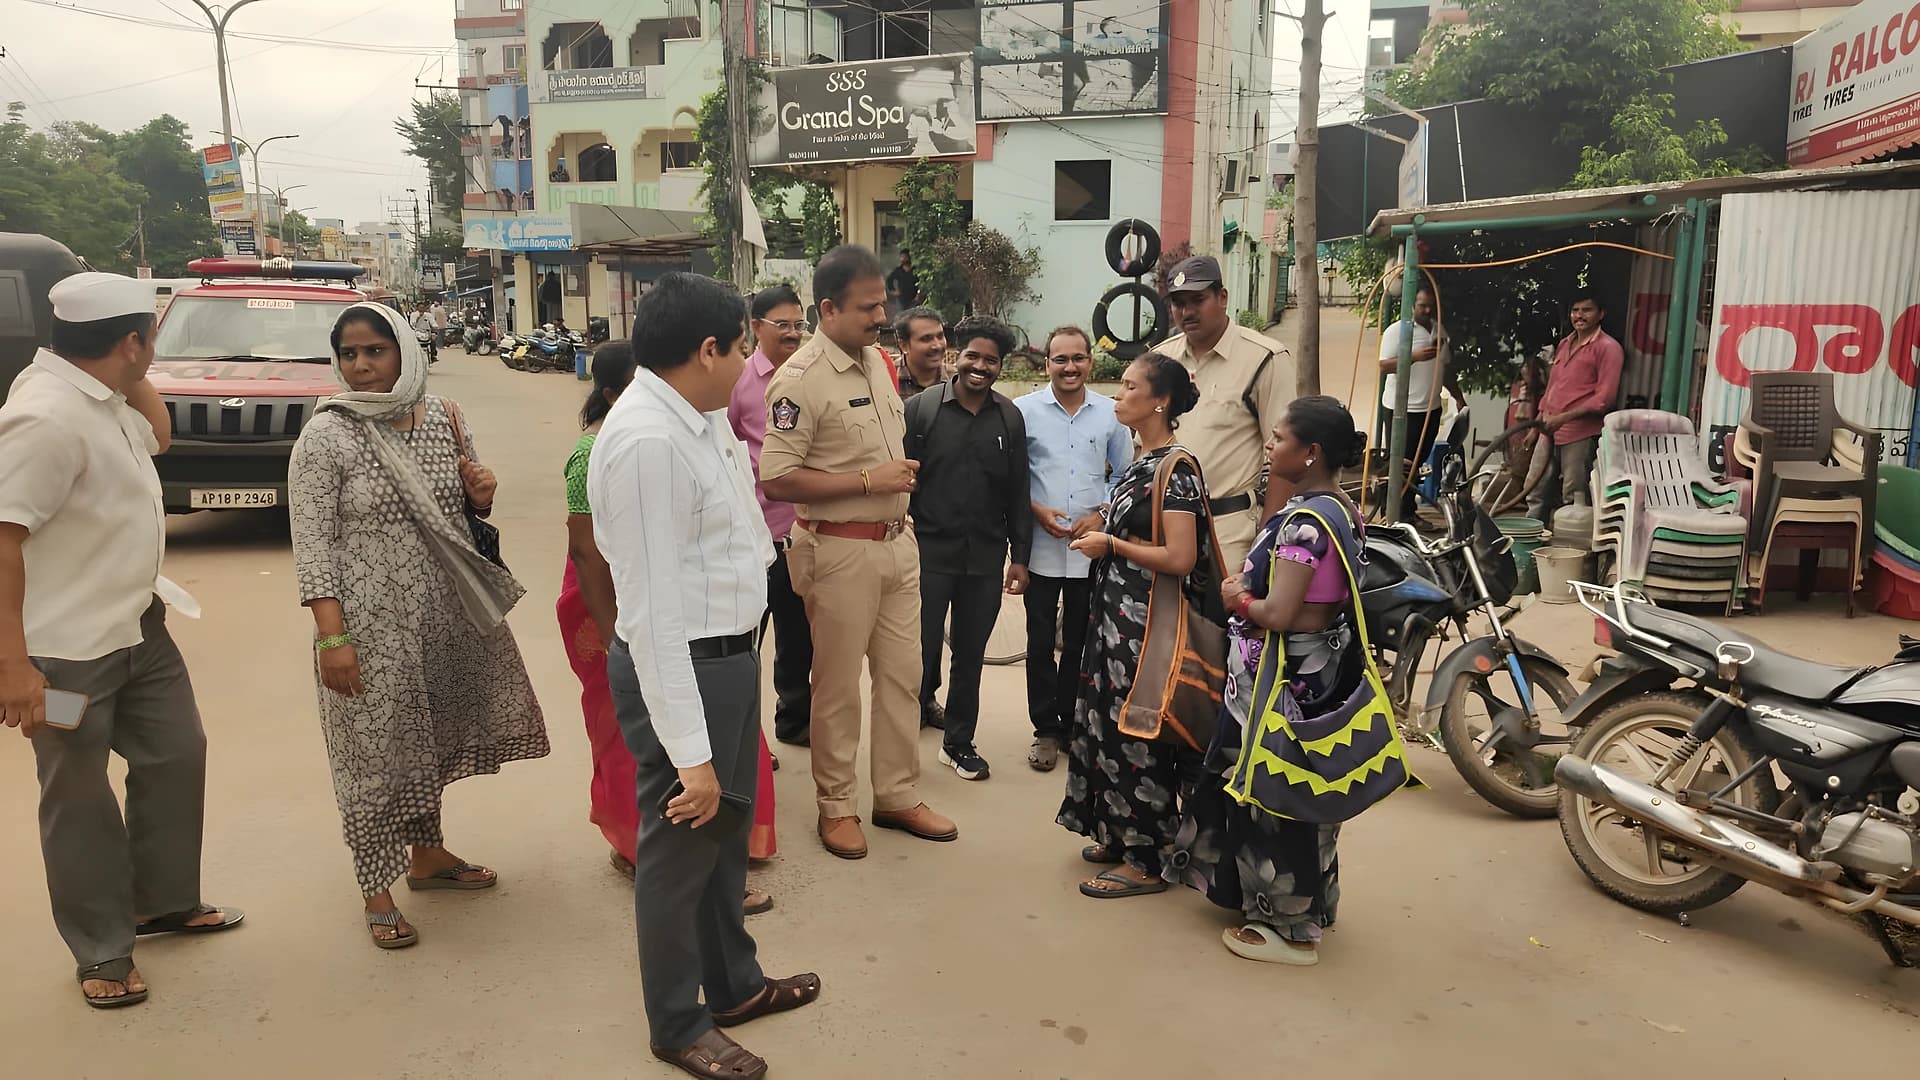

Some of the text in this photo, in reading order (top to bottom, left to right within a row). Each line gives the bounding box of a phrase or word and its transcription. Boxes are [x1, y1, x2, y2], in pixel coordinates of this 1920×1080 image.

[1826, 0, 1920, 88] RALCO
[826, 68, 867, 93] SSS
[781, 94, 904, 130] Grand Spa
[1823, 83, 1855, 111] TYRES
